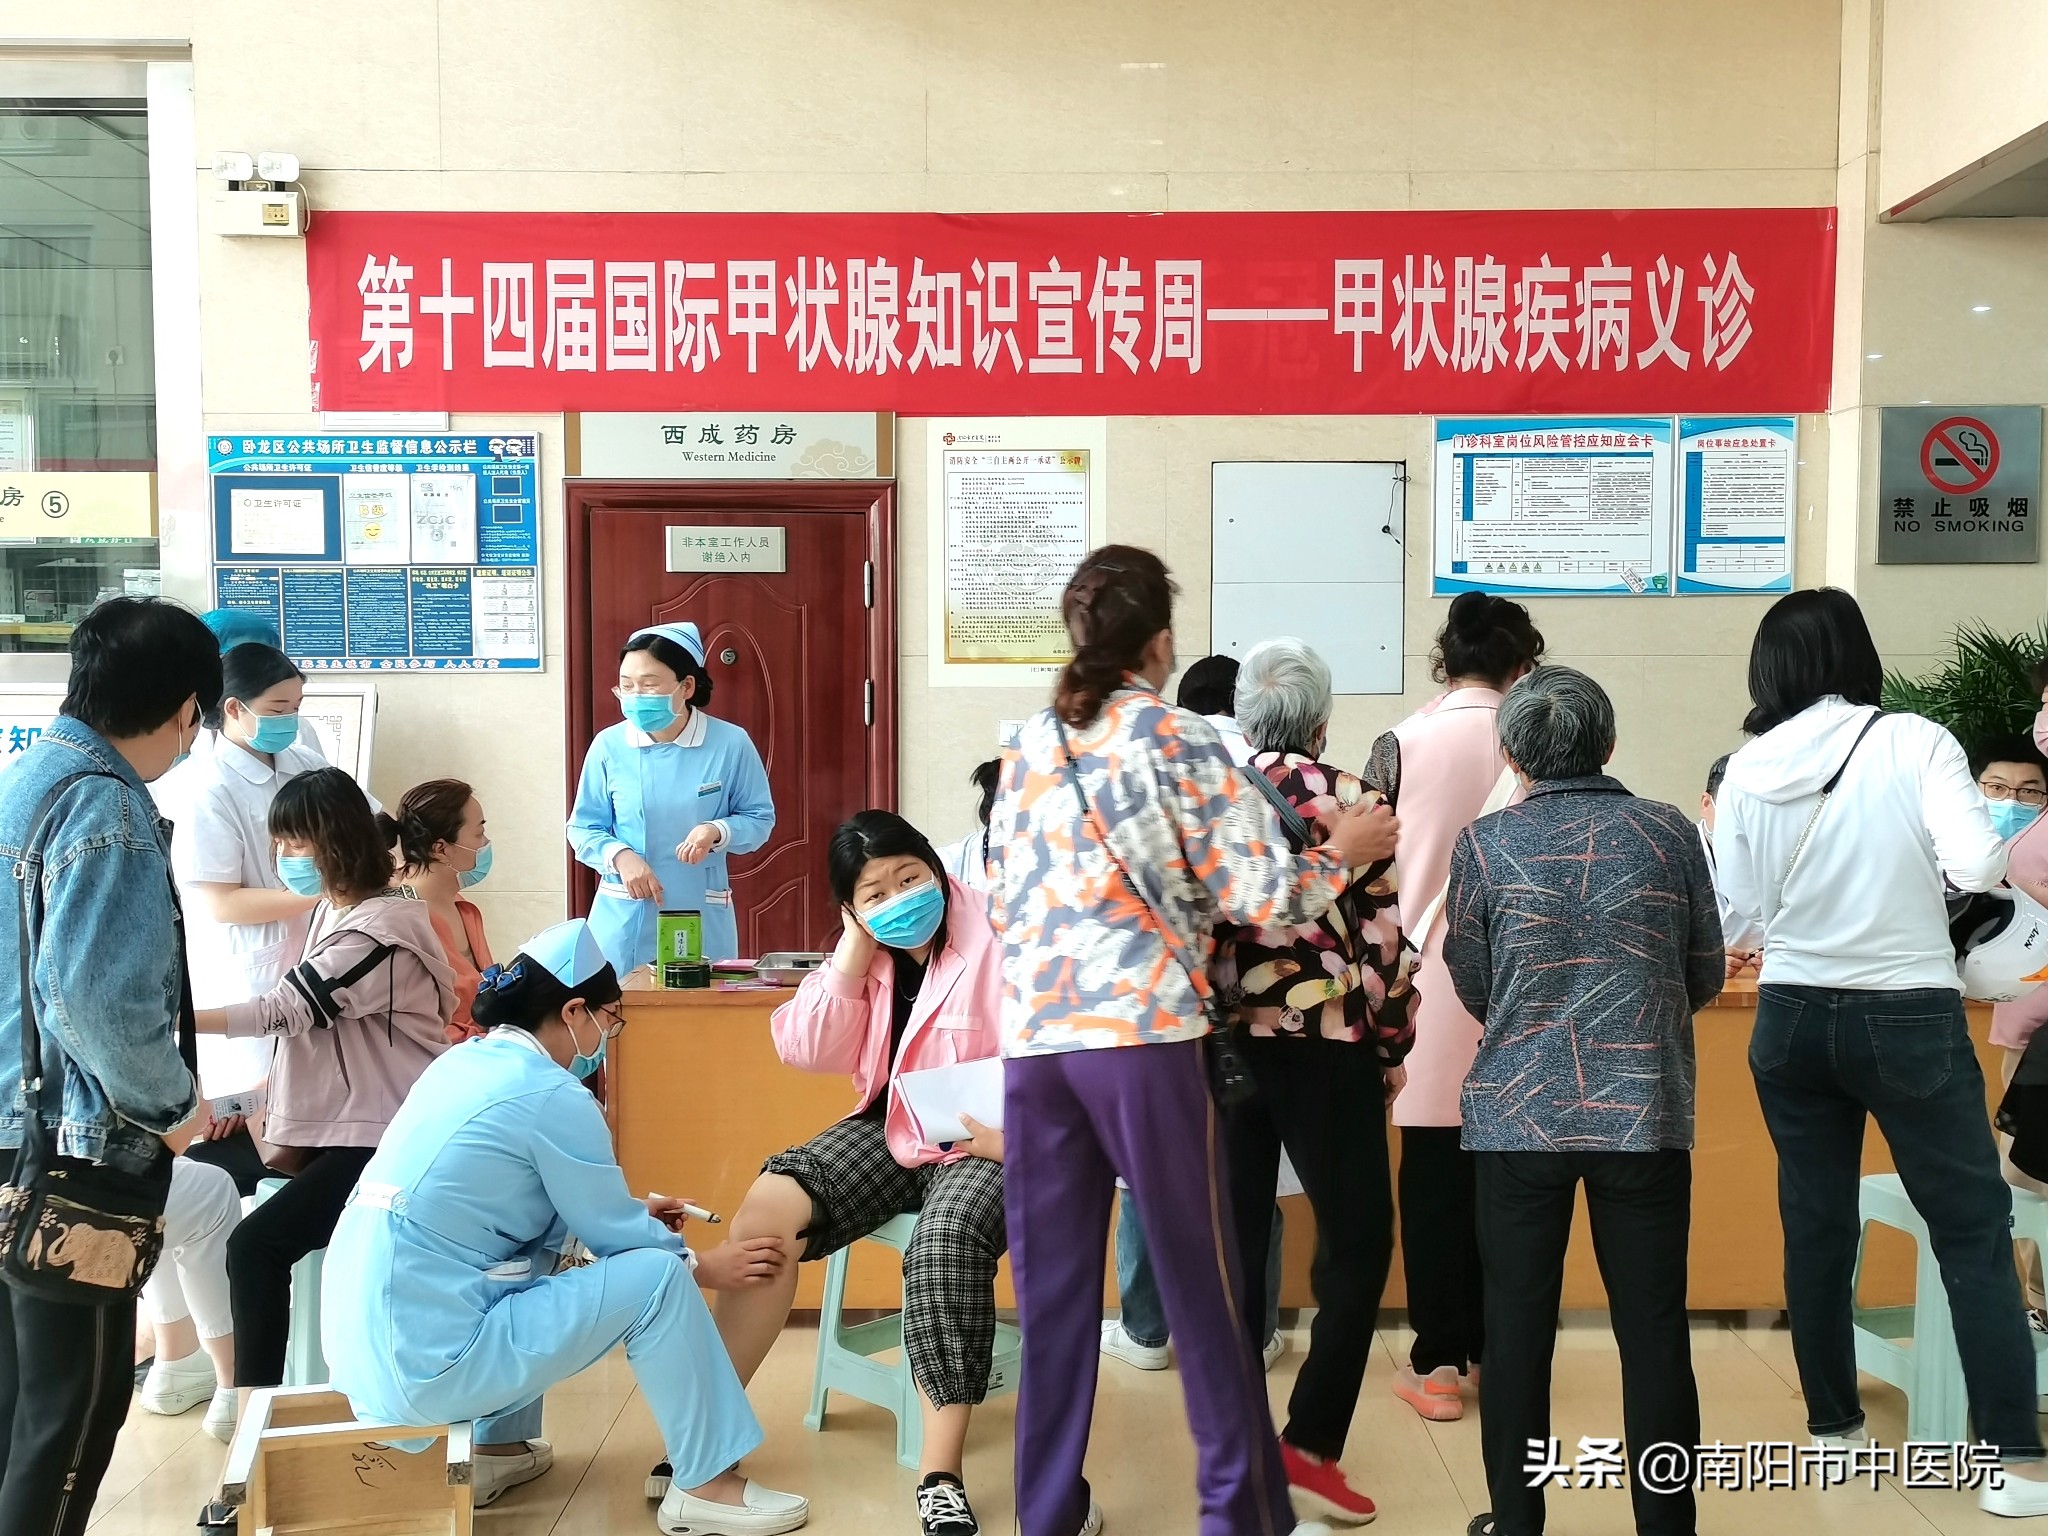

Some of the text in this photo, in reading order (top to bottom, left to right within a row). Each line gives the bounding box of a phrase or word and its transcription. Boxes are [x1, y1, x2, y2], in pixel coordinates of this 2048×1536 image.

[357, 251, 1755, 376] 第十四届国际甲状腺知识宣传周——甲状腺疾病义诊
[661, 424, 797, 445] 西成药房
[1453, 433, 1654, 449] 门诊科室岗位风险管控应知应会卡
[242, 439, 478, 455] 卧龙区公共场所卫生监督信息公示栏
[1697, 438, 1776, 448] 岗位事故应急处置卡
[682, 451, 776, 462] Western Medicine
[1893, 497, 2028, 518] 禁止吸烟
[1894, 520, 2024, 532] NO SMOKING
[682, 536, 769, 548] 非本室工作人员
[701, 551, 751, 563] 谢绝入内
